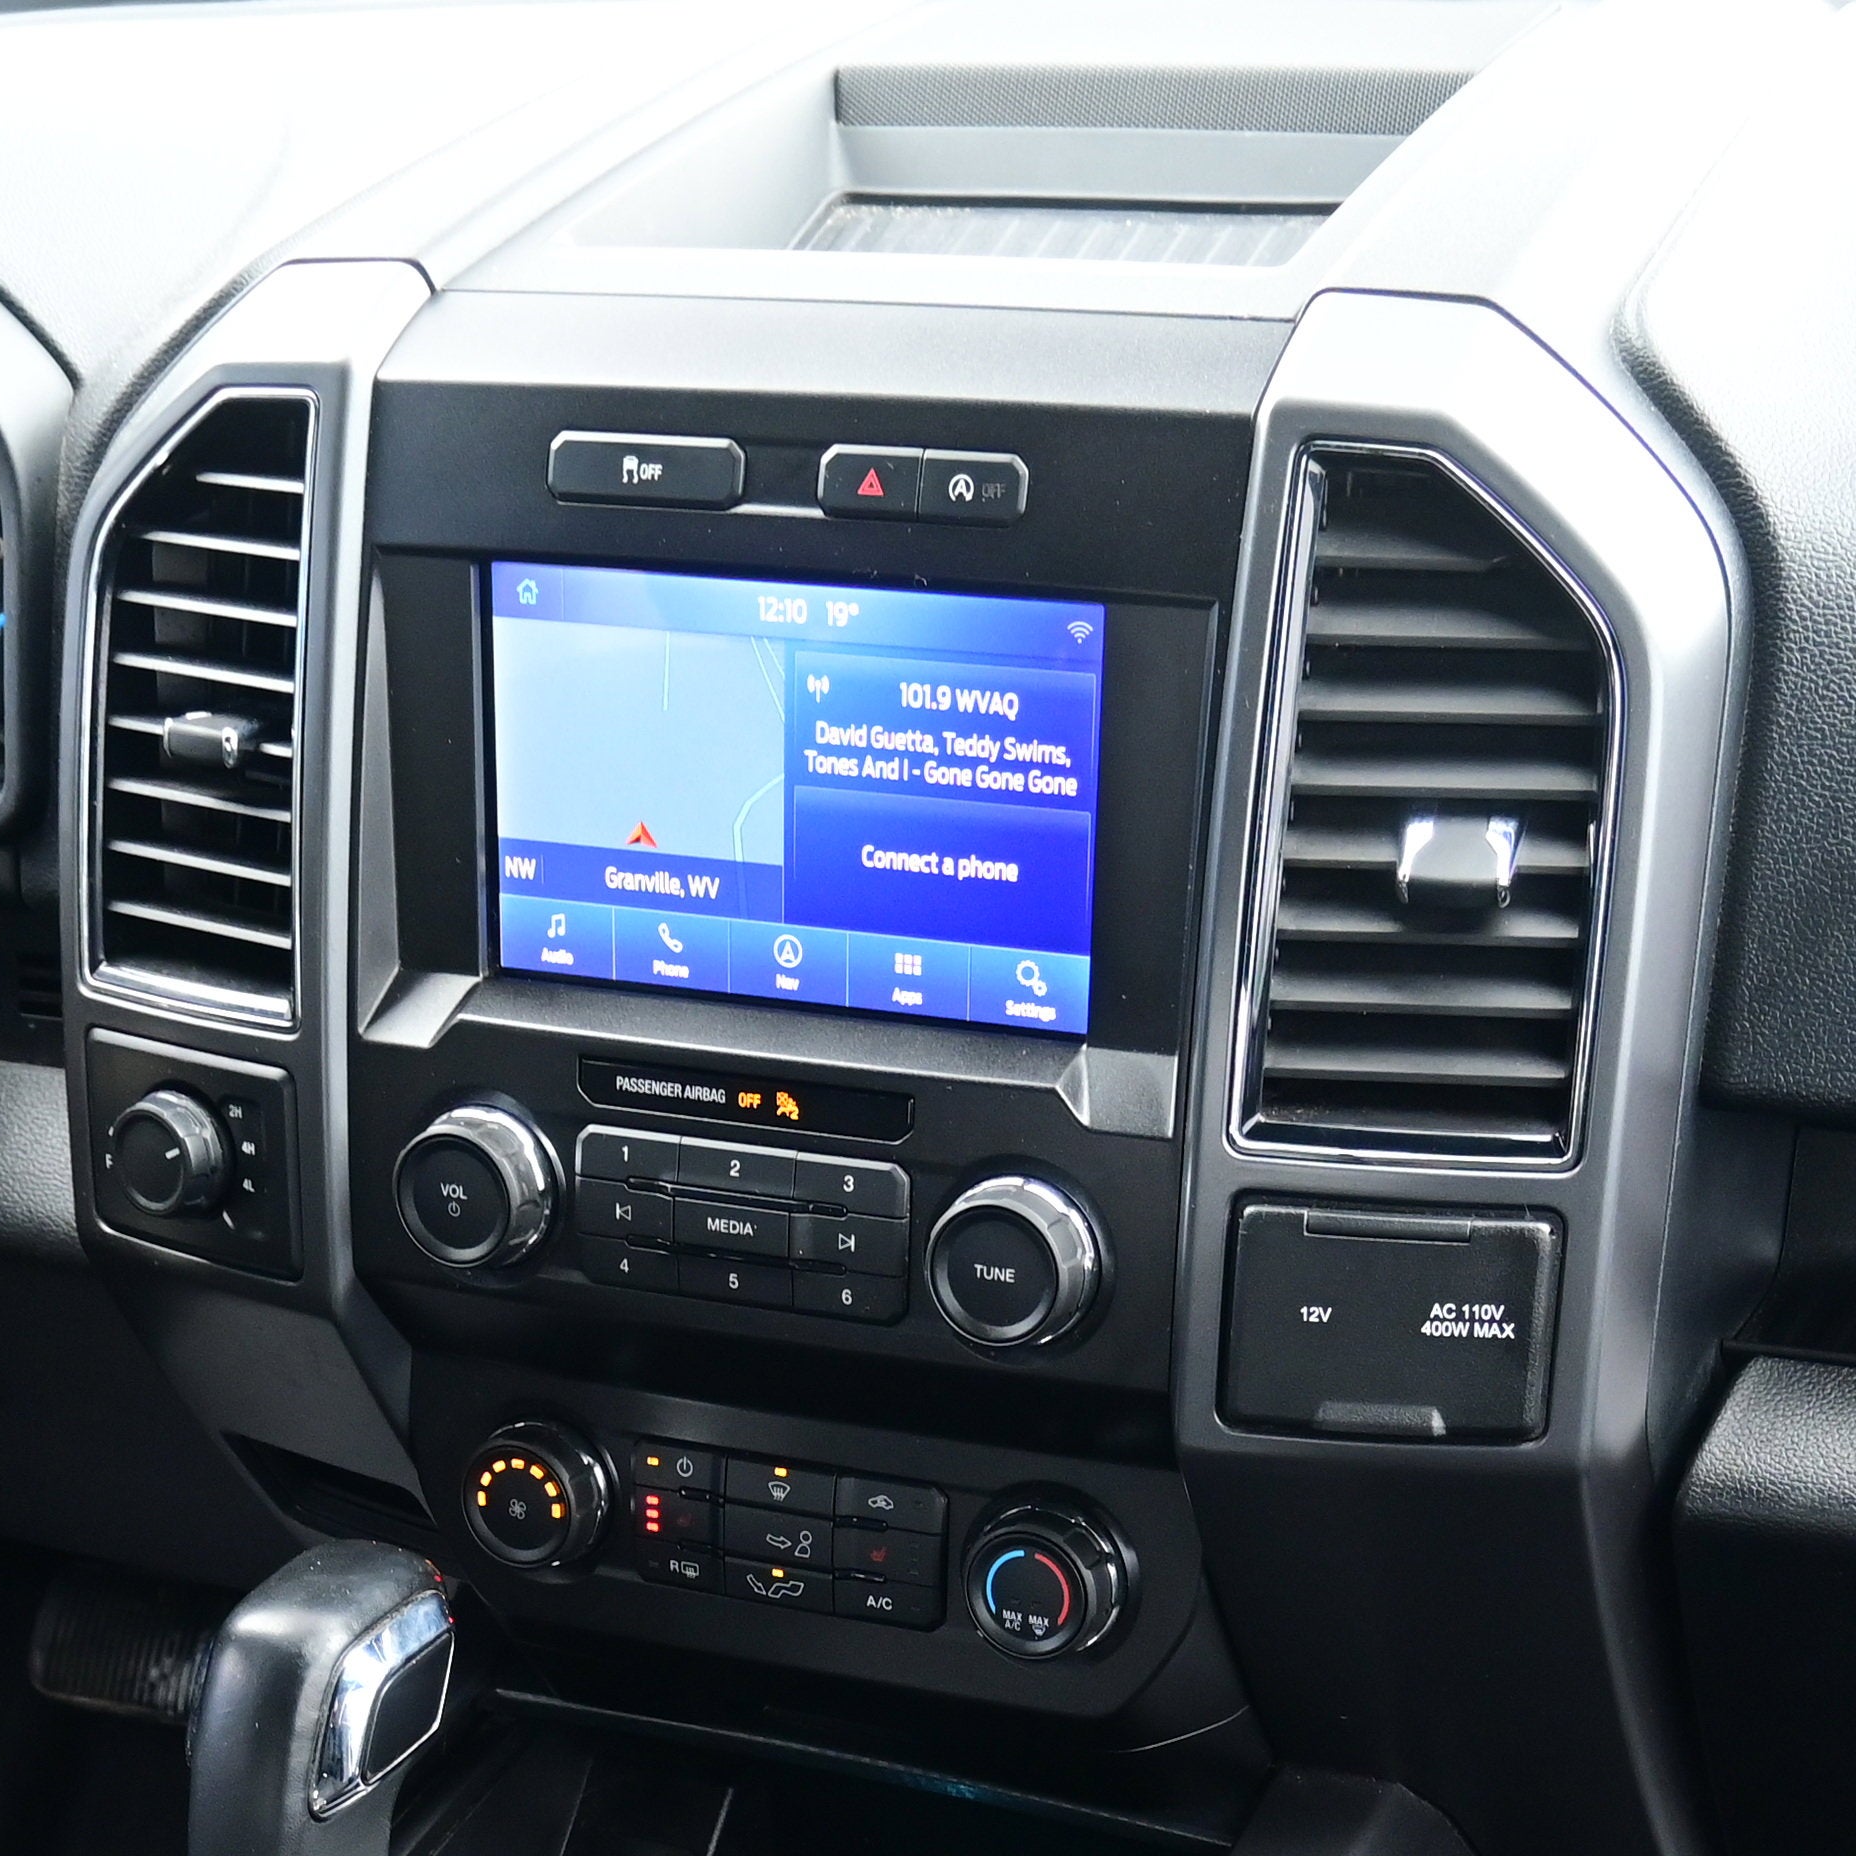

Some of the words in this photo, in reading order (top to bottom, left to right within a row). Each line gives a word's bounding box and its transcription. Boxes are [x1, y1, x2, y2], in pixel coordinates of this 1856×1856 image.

[640, 464, 664, 481] OFF
[758, 596, 807, 624] 12:10
[826, 601, 859, 626] 19°
[900, 682, 951, 711] 101.9
[955, 688, 1019, 721] WVAQ
[815, 720, 867, 748] David
[871, 726, 939, 756] Guetta,
[942, 731, 1000, 763] Teddy
[1003, 737, 1071, 768] Swims,
[804, 749, 859, 778] Tones
[861, 755, 899, 780] And
[903, 758, 909, 781] I
[923, 760, 972, 787] Gone
[975, 765, 1024, 791] Gone
[1028, 770, 1077, 796] Gone
[505, 855, 536, 880] NW
[861, 844, 939, 874] Connect
[942, 856, 955, 876] a
[957, 854, 1018, 883] phone
[605, 866, 685, 898] Granville,
[688, 874, 720, 899] WV
[541, 947, 574, 966] Audio
[652, 959, 690, 979] Phone
[775, 973, 800, 991] Nav
[892, 987, 923, 1006] Apps
[1005, 999, 1056, 1022] Settings
[616, 1075, 682, 1099] PASSENGER
[684, 1084, 726, 1104] AIRBAG
[738, 1091, 761, 1109] OFF
[229, 1104, 243, 1119] 2H
[242, 1141, 256, 1156] 4H
[622, 1146, 628, 1162] 1
[730, 1160, 740, 1178] 2
[243, 1178, 255, 1193] 4L
[440, 1183, 467, 1200] VOL
[844, 1175, 854, 1192] 3
[707, 1217, 754, 1237] MEDIA
[619, 1258, 629, 1274] 4
[973, 1263, 1016, 1284] TUNE
[729, 1272, 739, 1290] 5
[842, 1289, 852, 1305] 6
[1300, 1306, 1332, 1323] 12V
[1430, 1303, 1457, 1320] AC
[1462, 1303, 1505, 1321] 110V
[1420, 1320, 1470, 1338] 400W
[1473, 1322, 1515, 1339] MAX
[866, 1595, 892, 1611] A/C
[1002, 1609, 1022, 1622] MAX
[1028, 1614, 1049, 1628] MAX
[1005, 1619, 1020, 1632] A/C
